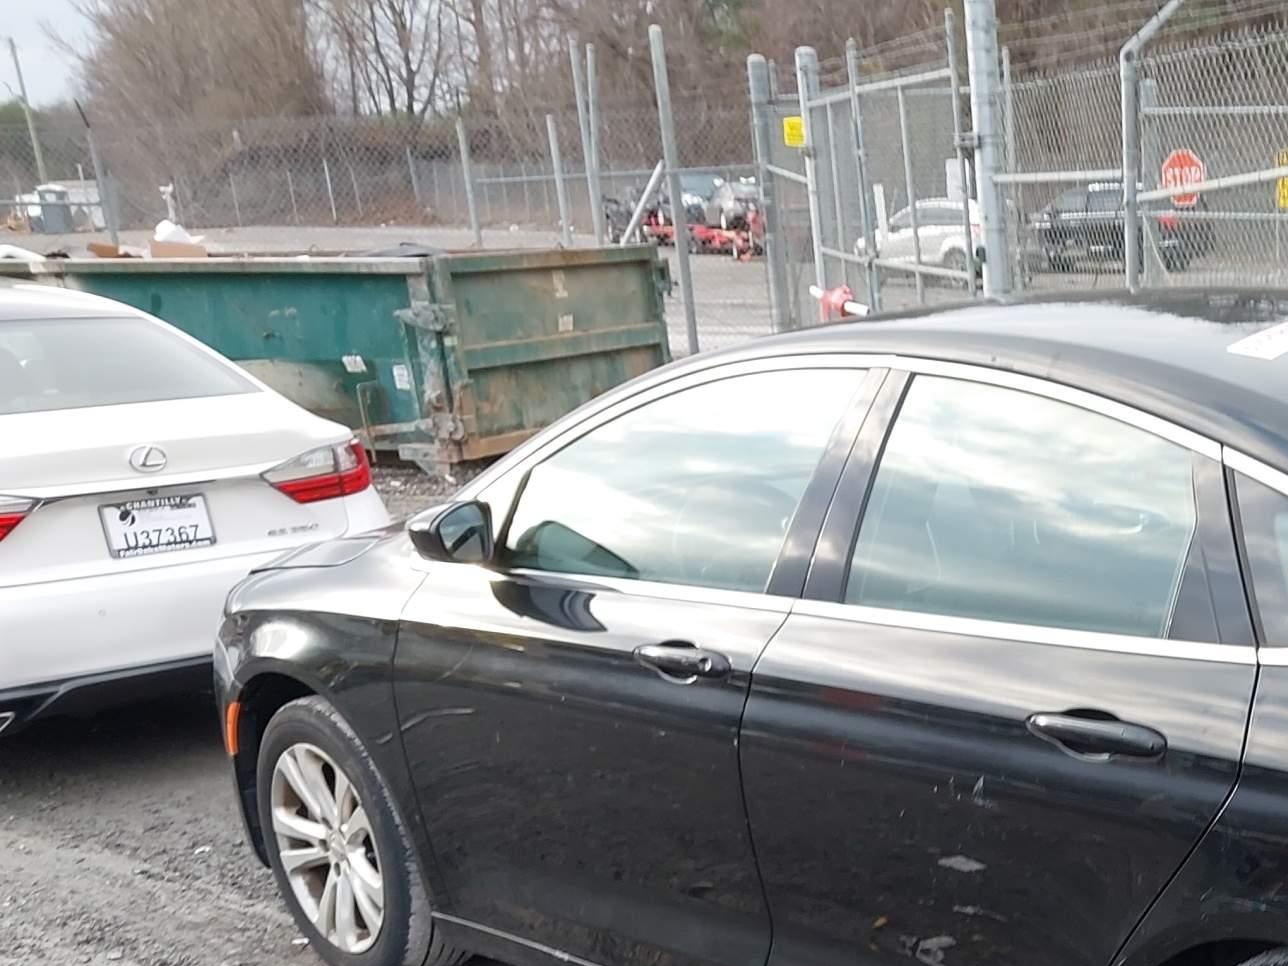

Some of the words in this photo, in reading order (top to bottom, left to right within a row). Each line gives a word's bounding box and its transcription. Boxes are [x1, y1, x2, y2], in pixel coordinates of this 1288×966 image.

[1166, 167, 1201, 187] STOP
[126, 497, 181, 510] CHANTILLY
[123, 525, 199, 549] U37367
